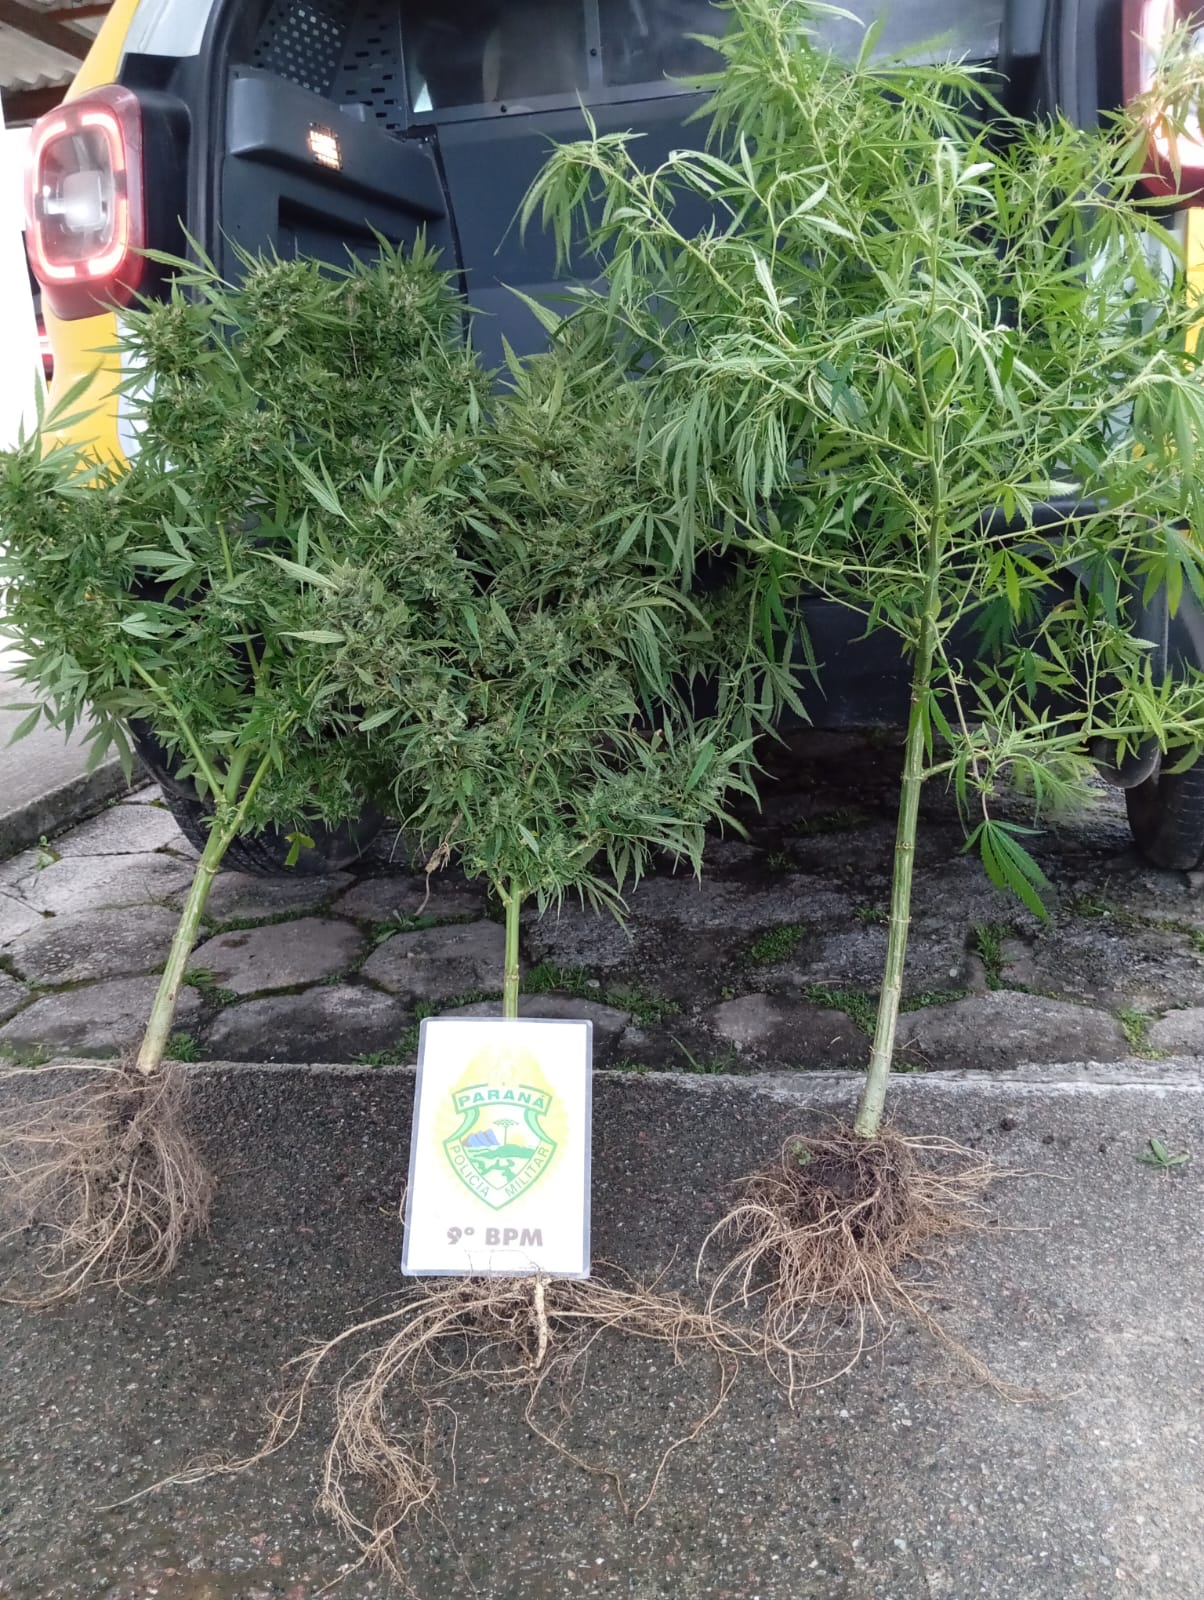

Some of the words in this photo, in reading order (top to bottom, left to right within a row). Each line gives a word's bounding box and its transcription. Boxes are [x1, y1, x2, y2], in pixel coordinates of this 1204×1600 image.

[458, 1089, 546, 1109] PARANÁ
[505, 1145, 550, 1198] MILITAR
[484, 1227, 544, 1247] BPM
